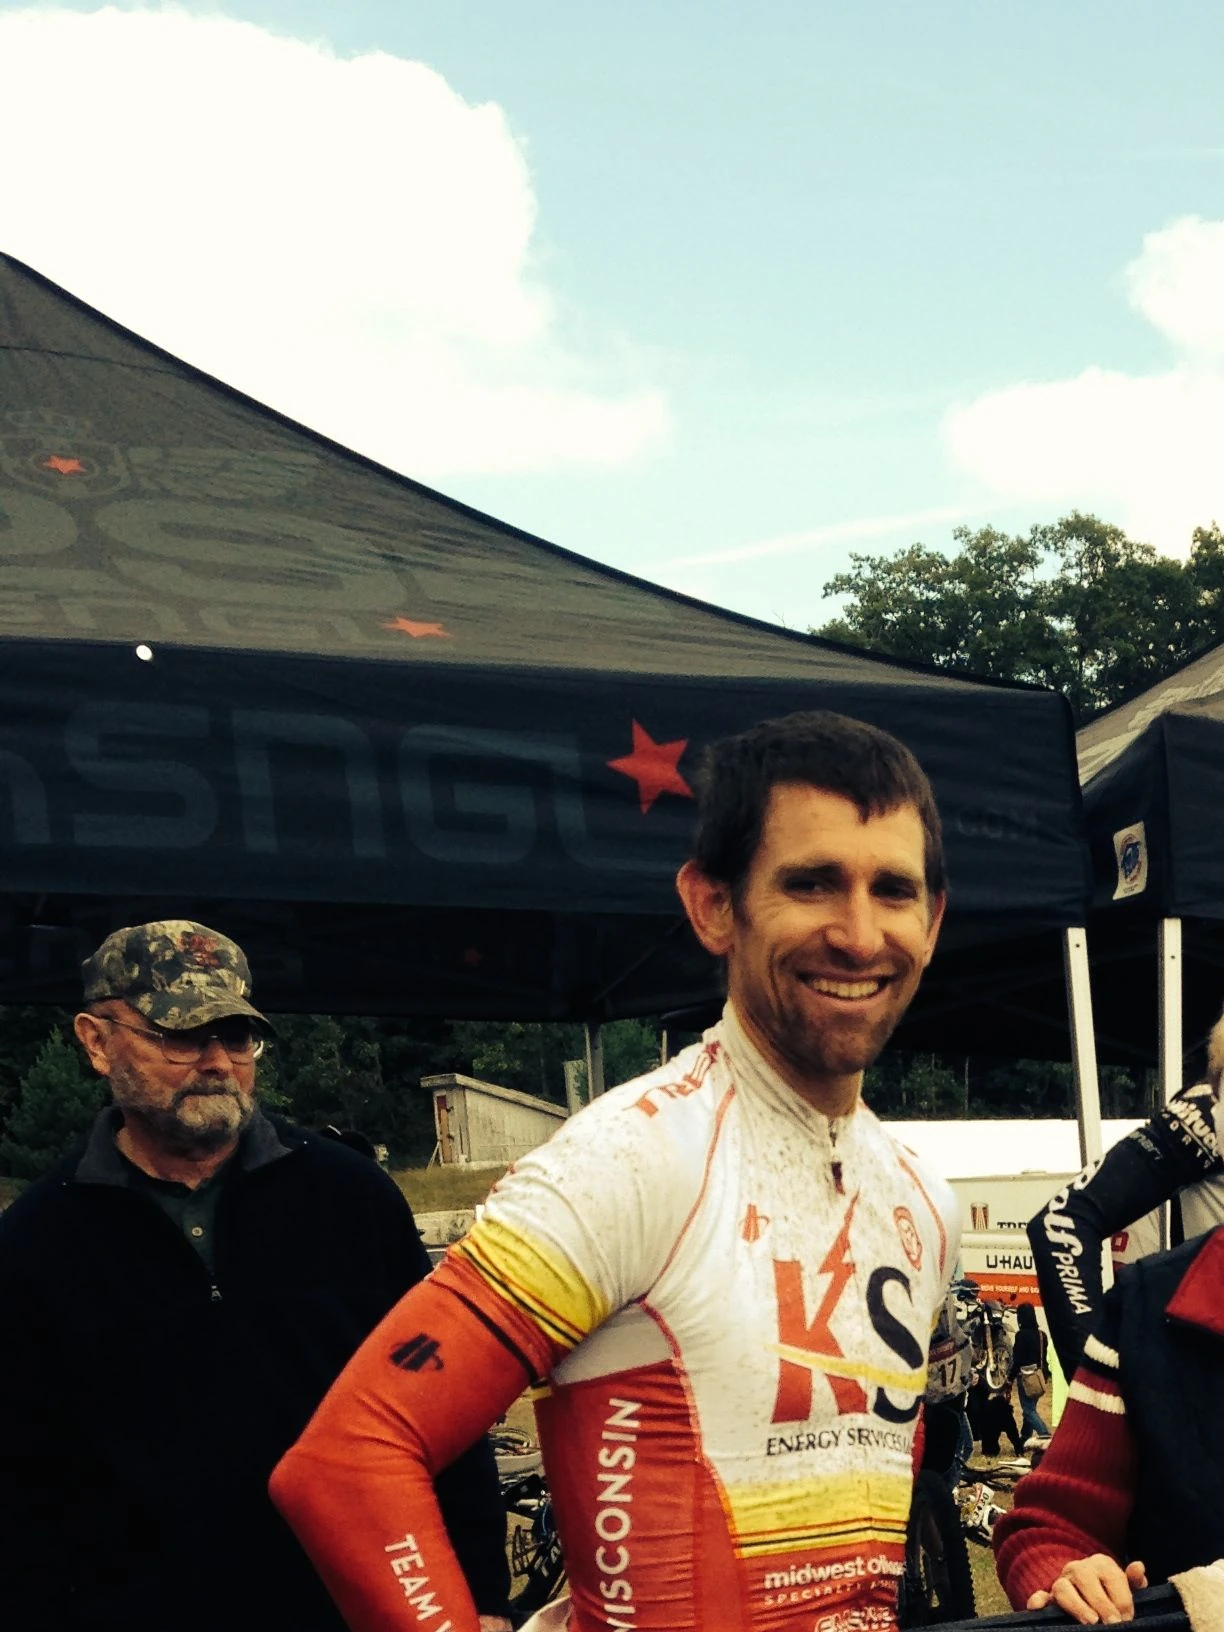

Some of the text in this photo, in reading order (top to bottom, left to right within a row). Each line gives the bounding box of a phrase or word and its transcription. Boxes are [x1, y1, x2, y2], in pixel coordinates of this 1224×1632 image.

[986, 1254, 1034, 1270] U-HAU
[771, 1187, 929, 1424] KS
[766, 1430, 842, 1456] ENERGY
[384, 1533, 443, 1622] TEAM
[763, 1556, 865, 1590] midwest
